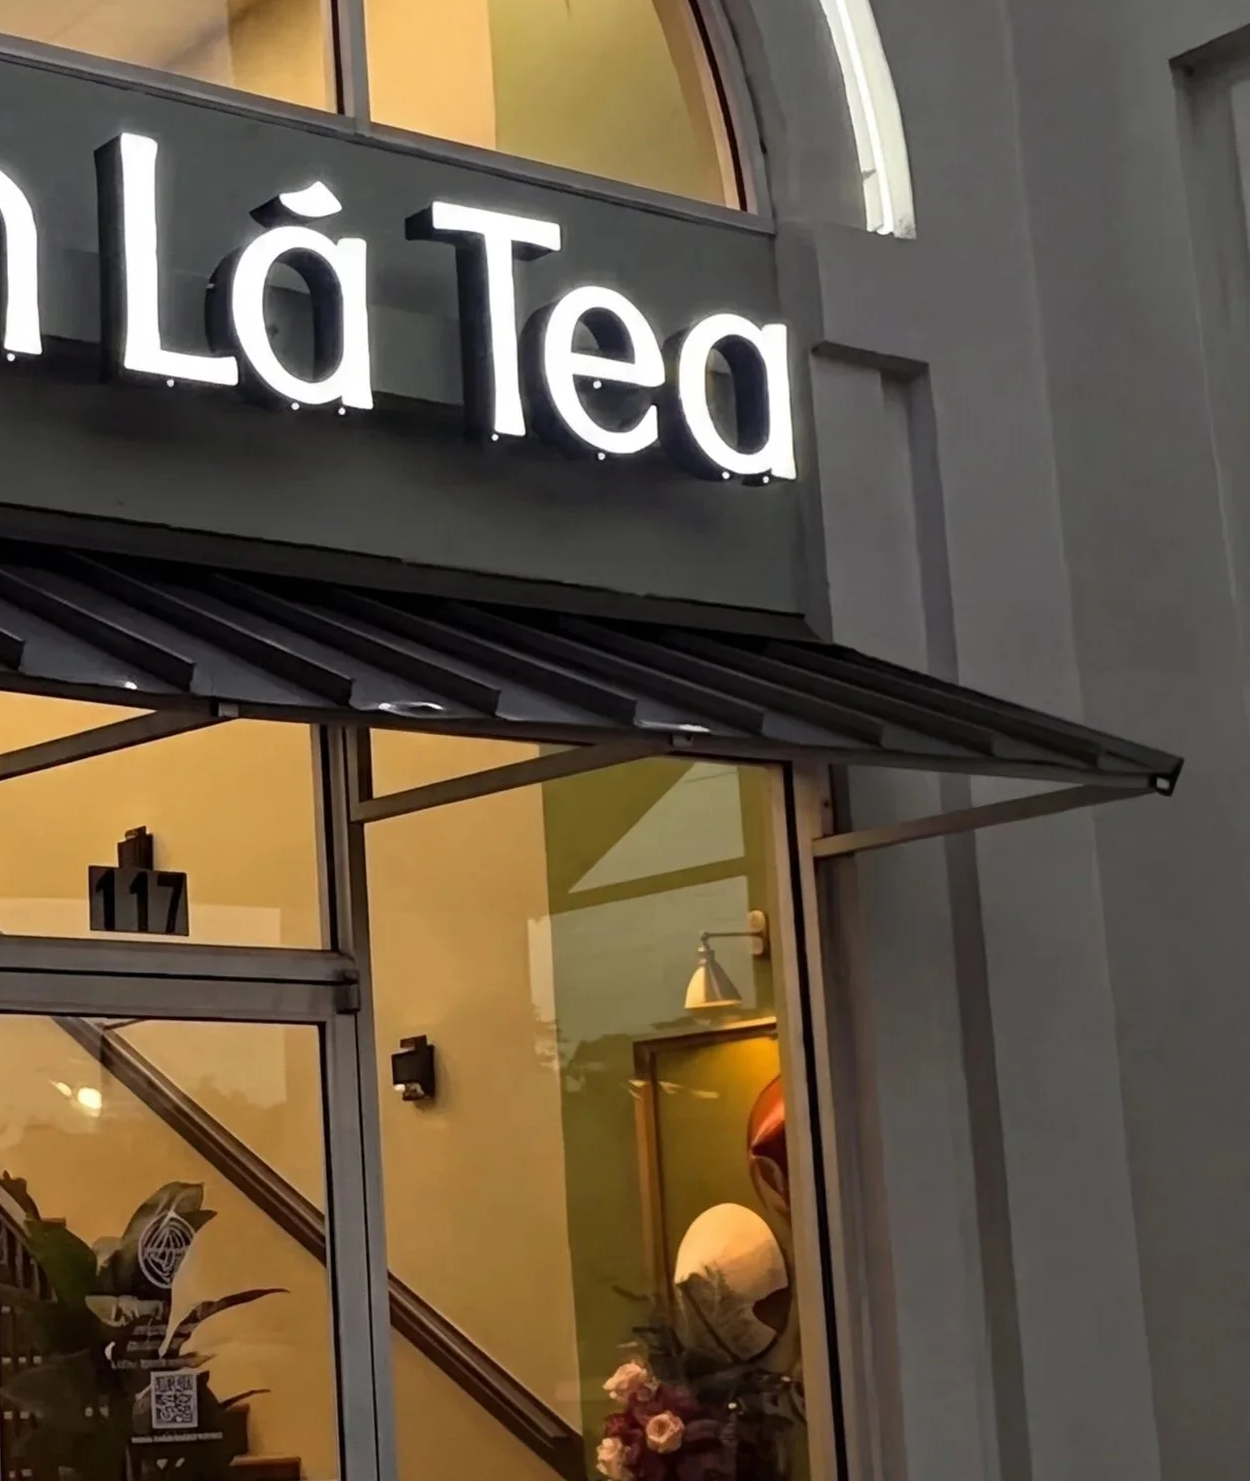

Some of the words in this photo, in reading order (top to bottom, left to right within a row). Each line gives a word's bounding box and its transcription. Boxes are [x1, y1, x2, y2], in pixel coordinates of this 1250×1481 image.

[112, 132, 374, 410] Lá
[426, 200, 796, 482] Tea
[95, 869, 186, 935] 117
